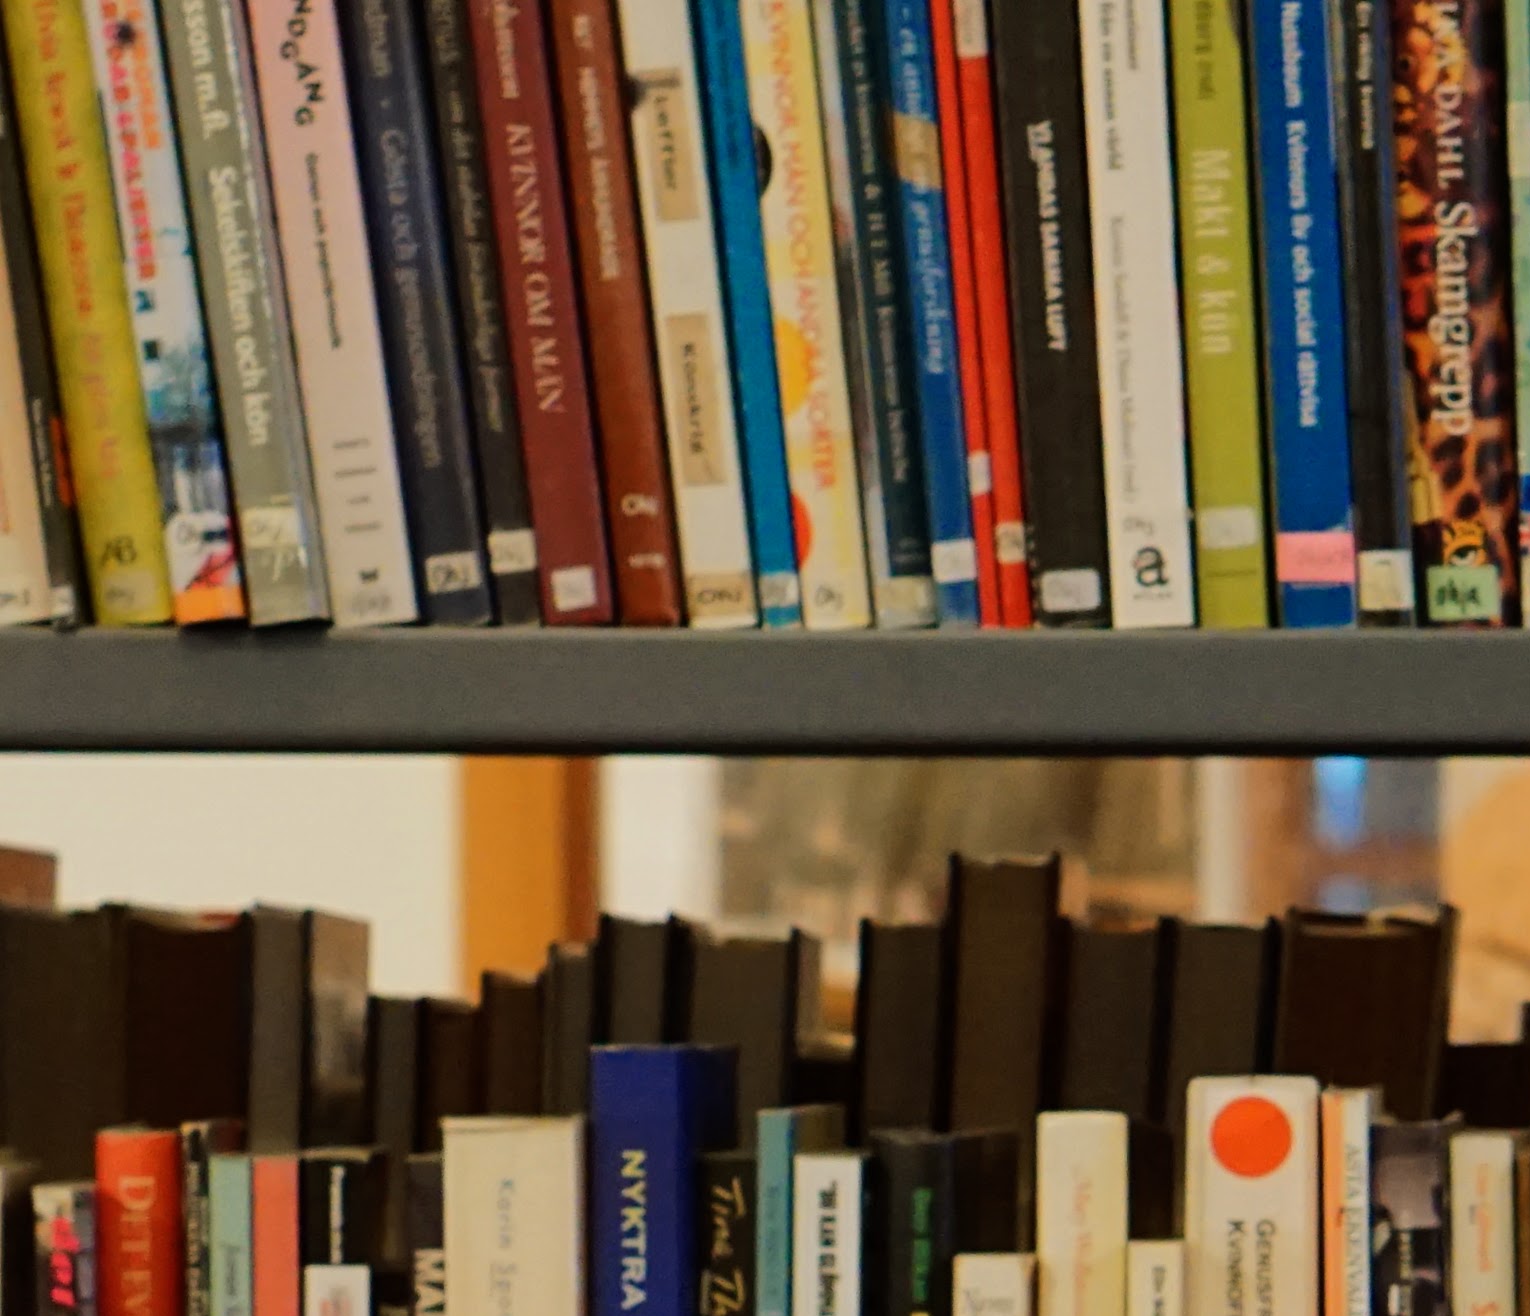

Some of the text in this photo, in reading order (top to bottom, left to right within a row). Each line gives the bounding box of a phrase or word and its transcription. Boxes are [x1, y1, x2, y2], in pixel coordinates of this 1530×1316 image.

[1188, 147, 1236, 241] Makt
[1290, 242, 1316, 285] och
[1423, 82, 1485, 436] DAHL Skamgrepp
[520, 270, 555, 329] OM
[1195, 288, 1241, 357] kön
[1292, 285, 1319, 347] social
[232, 333, 267, 391] och
[241, 391, 275, 447] kön
[117, 1173, 156, 1260] DET
[619, 1148, 646, 1310] NYKTRA
